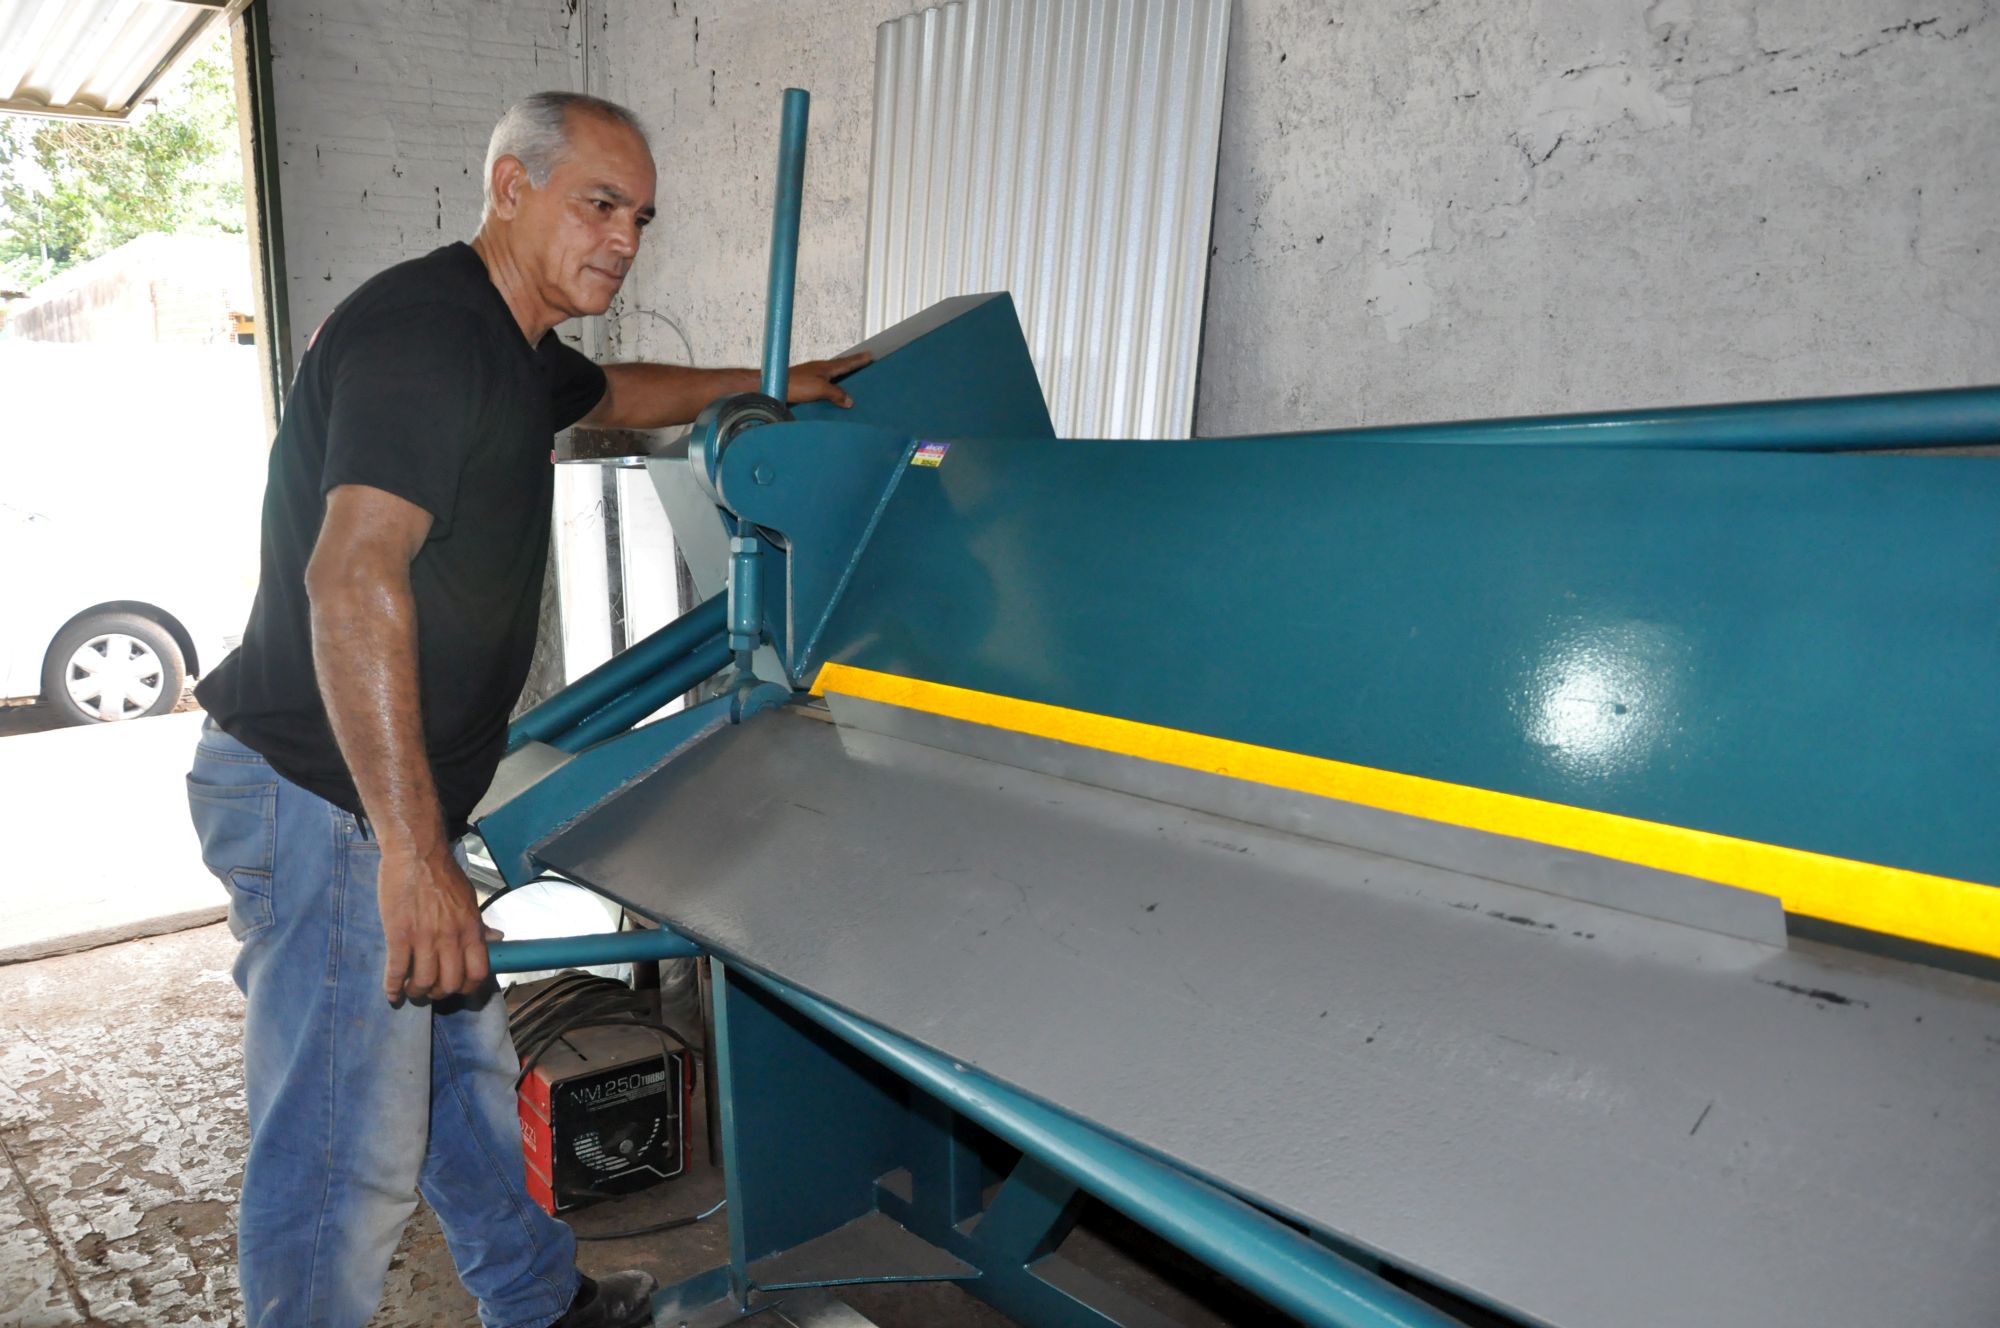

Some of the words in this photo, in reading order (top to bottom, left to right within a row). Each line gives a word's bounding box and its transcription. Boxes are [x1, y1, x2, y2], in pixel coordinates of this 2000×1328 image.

[570, 1084, 601, 1105] NM
[605, 1073, 641, 1097] 250
[640, 1070, 666, 1086] TURBO
